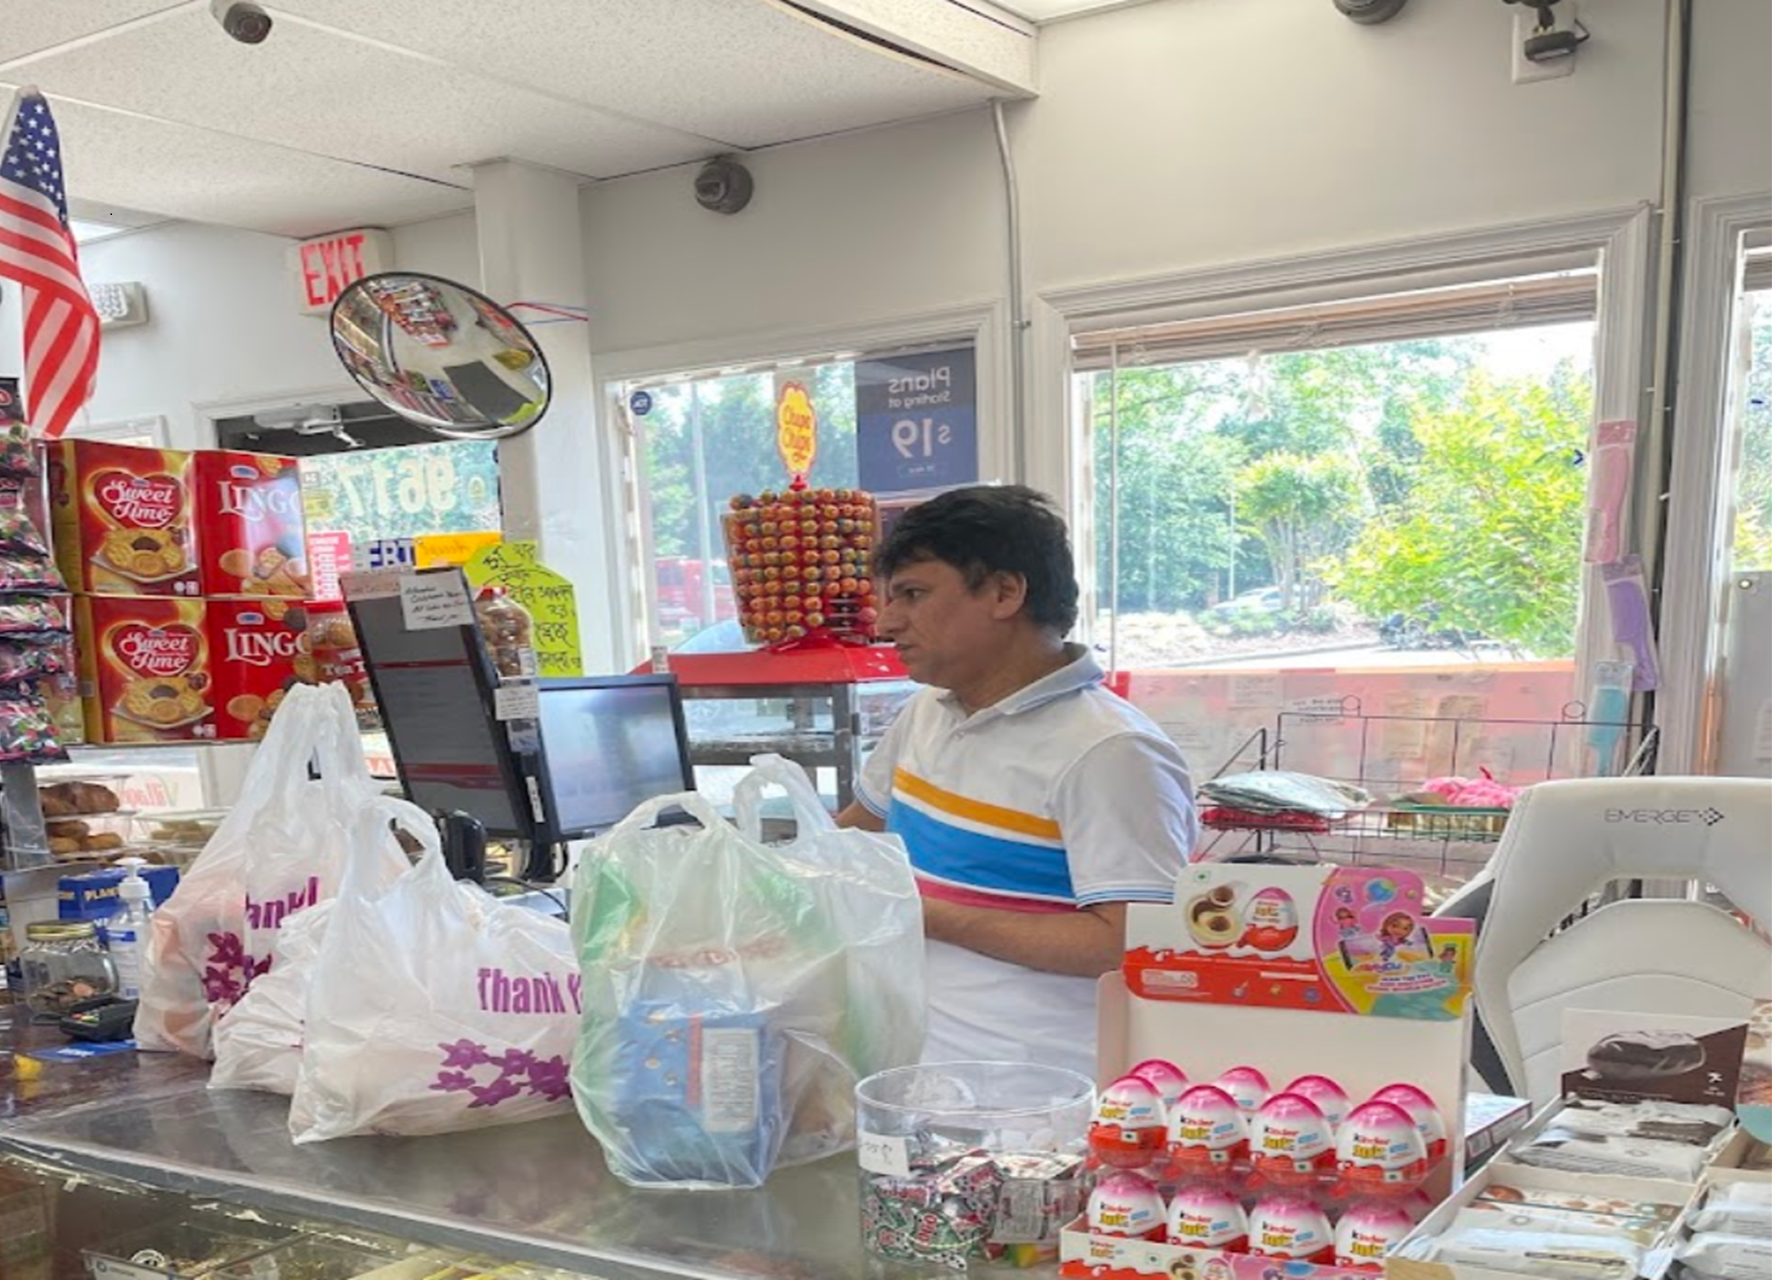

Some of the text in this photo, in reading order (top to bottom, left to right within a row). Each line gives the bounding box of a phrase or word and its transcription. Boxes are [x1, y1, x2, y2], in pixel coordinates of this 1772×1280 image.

[300, 233, 366, 307] EXIT
[101, 480, 173, 505] Sweet
[113, 501, 174, 529] Time
[119, 632, 189, 656] Sweet
[130, 649, 191, 677] Time
[477, 967, 566, 1014] Thank
